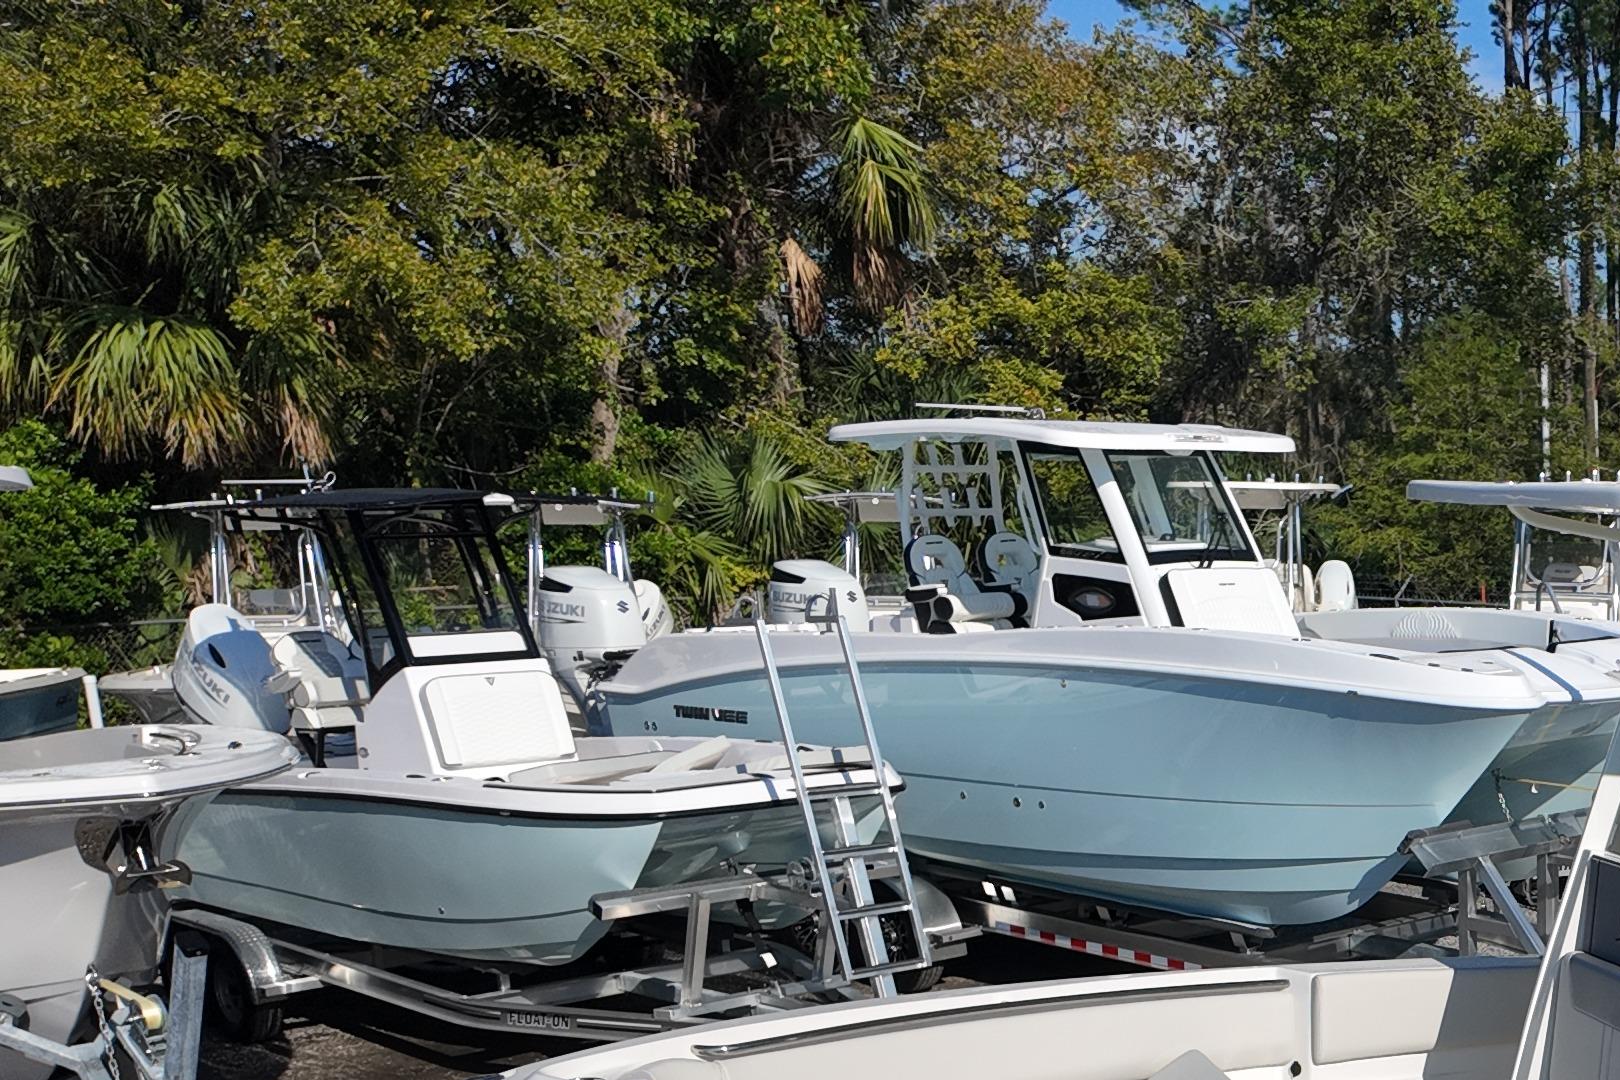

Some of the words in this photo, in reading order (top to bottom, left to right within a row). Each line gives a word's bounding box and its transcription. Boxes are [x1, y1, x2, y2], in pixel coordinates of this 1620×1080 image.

[672, 704, 710, 721] TWIN
[711, 707, 749, 725] VEE
[507, 1012, 570, 1030] FLOAT-ON
